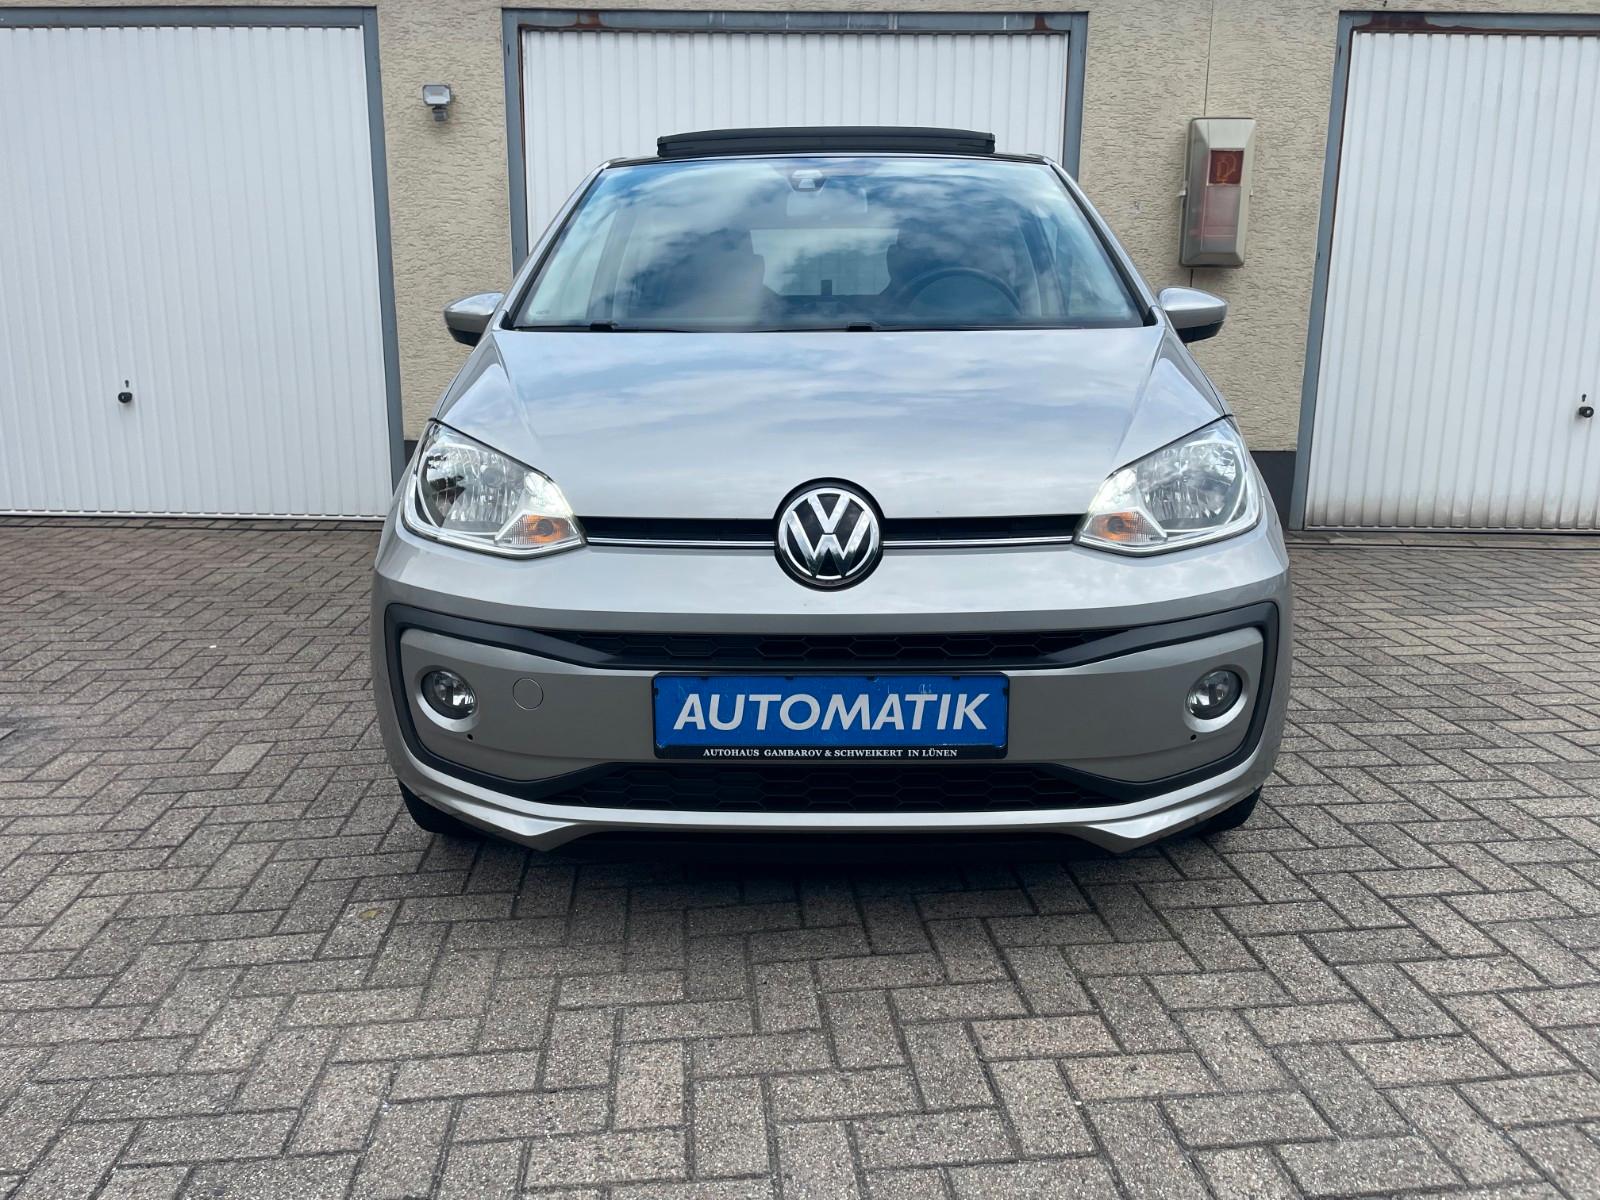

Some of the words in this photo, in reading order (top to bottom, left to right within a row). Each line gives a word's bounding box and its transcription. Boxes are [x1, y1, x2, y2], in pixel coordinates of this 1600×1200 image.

[779, 488, 880, 579] VW
[673, 694, 990, 730] AUTOMATIK
[703, 749, 760, 757] AUTOHAUS
[763, 749, 822, 757] GAMBAROV
[824, 749, 832, 757] &
[834, 749, 903, 757] SCHWEIKERT
[908, 749, 919, 757] IN
[922, 747, 958, 757] LÜNEN
